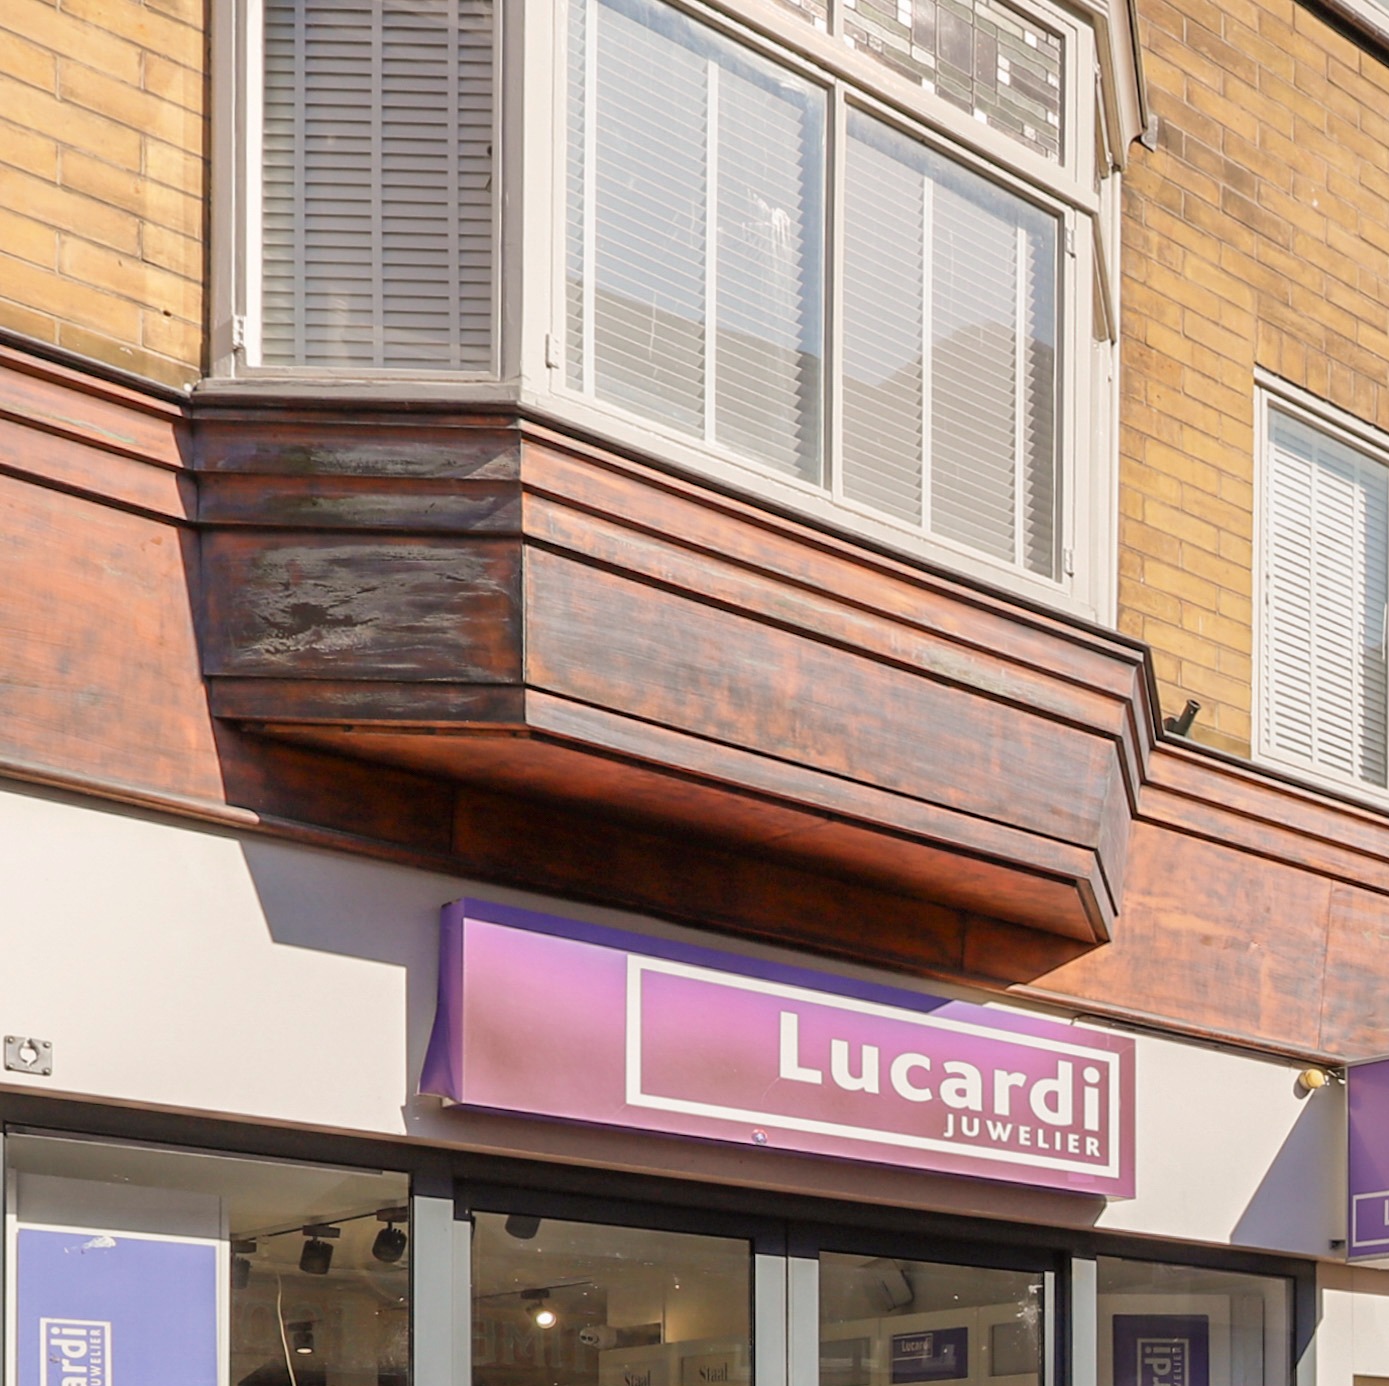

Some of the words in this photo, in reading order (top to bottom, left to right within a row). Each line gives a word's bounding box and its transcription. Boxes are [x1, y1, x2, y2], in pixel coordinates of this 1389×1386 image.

[780, 1010, 1101, 1131] Lucardi
[944, 1113, 1101, 1157] JUWELIER
[699, 1362, 728, 1383] Staal
